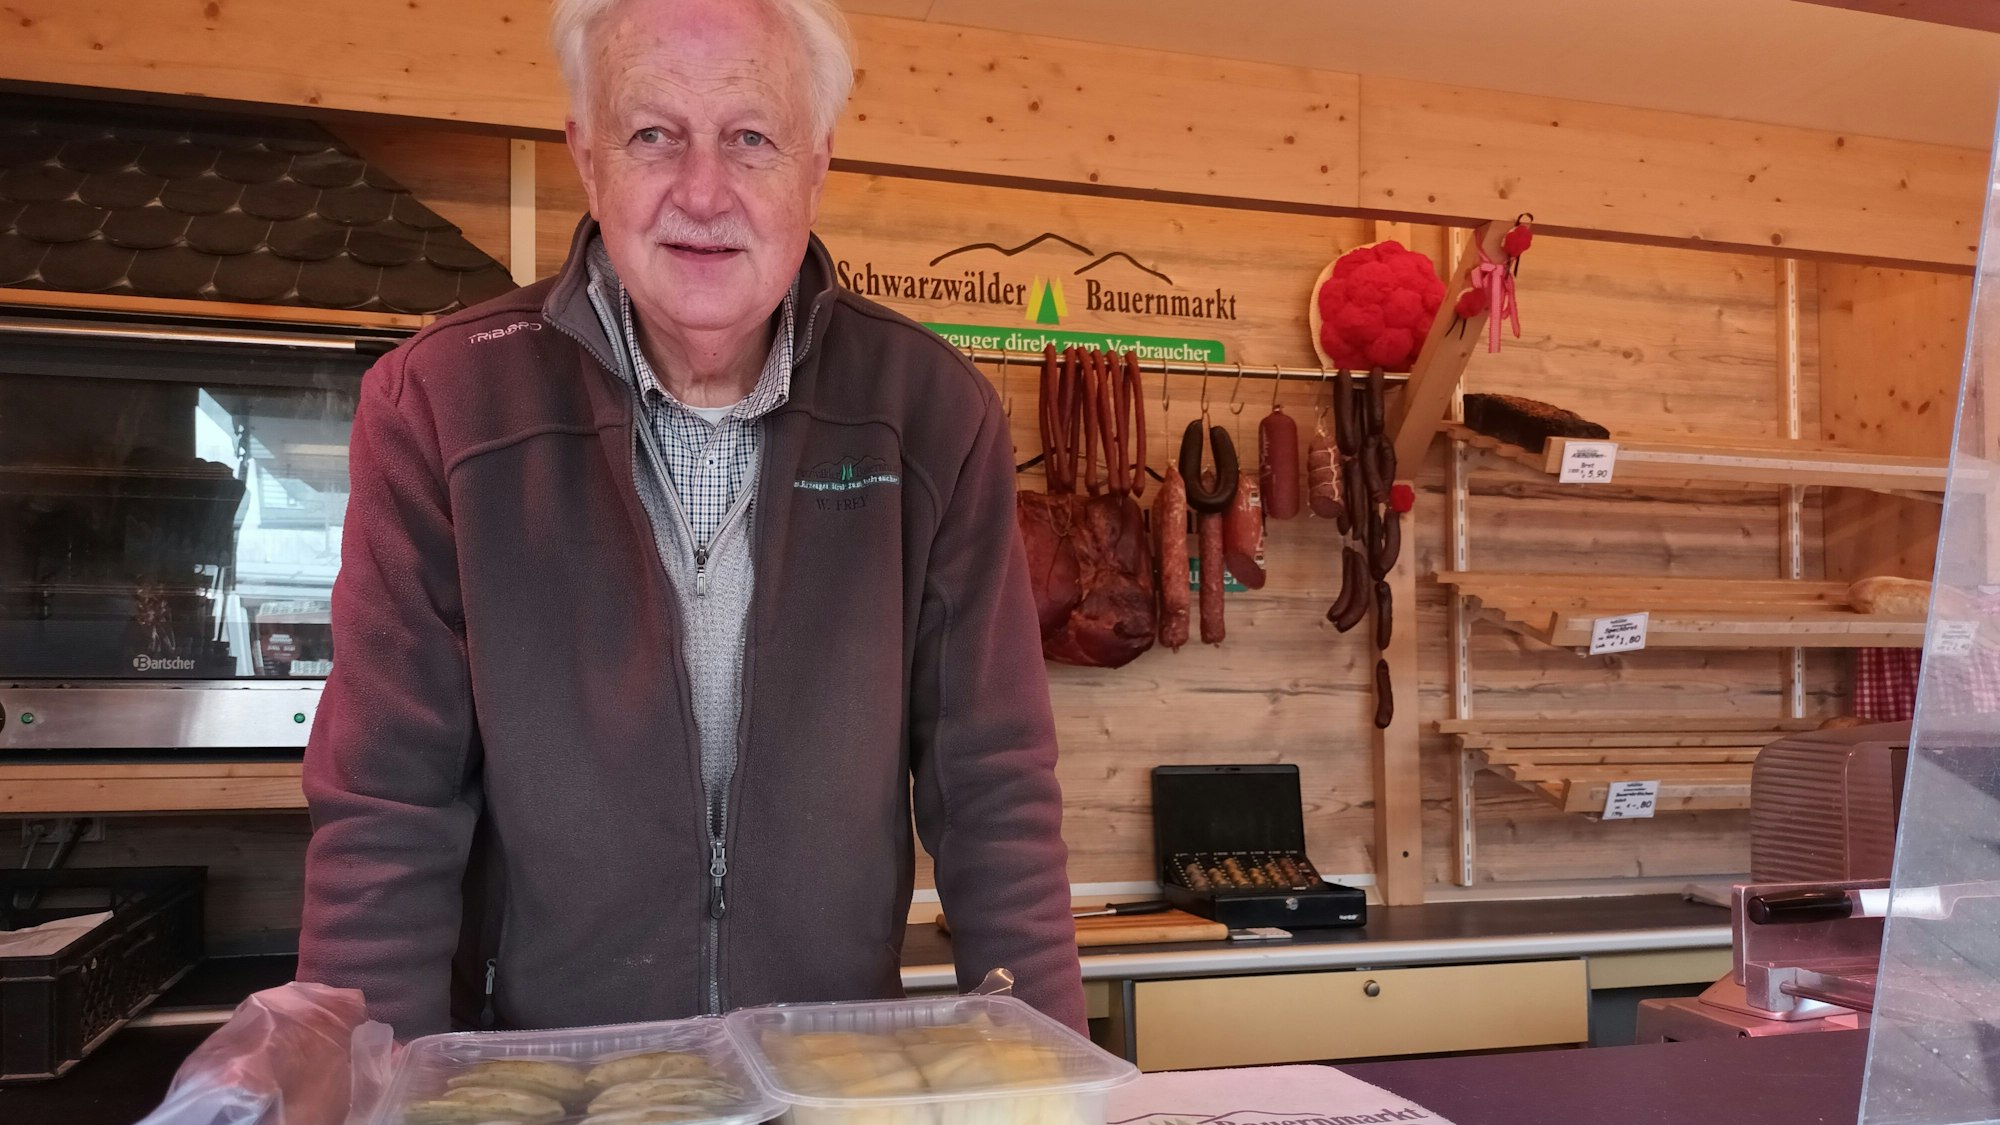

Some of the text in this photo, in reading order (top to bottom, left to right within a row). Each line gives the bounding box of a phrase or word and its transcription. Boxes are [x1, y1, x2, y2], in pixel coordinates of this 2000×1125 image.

[836, 260, 1237, 321] Schwarzwälder Bauernmarkt
[1105, 339, 1211, 362] Verbraucher
[132, 654, 196, 672] Bartscher
[1214, 1108, 1428, 1125] ernmarkt
